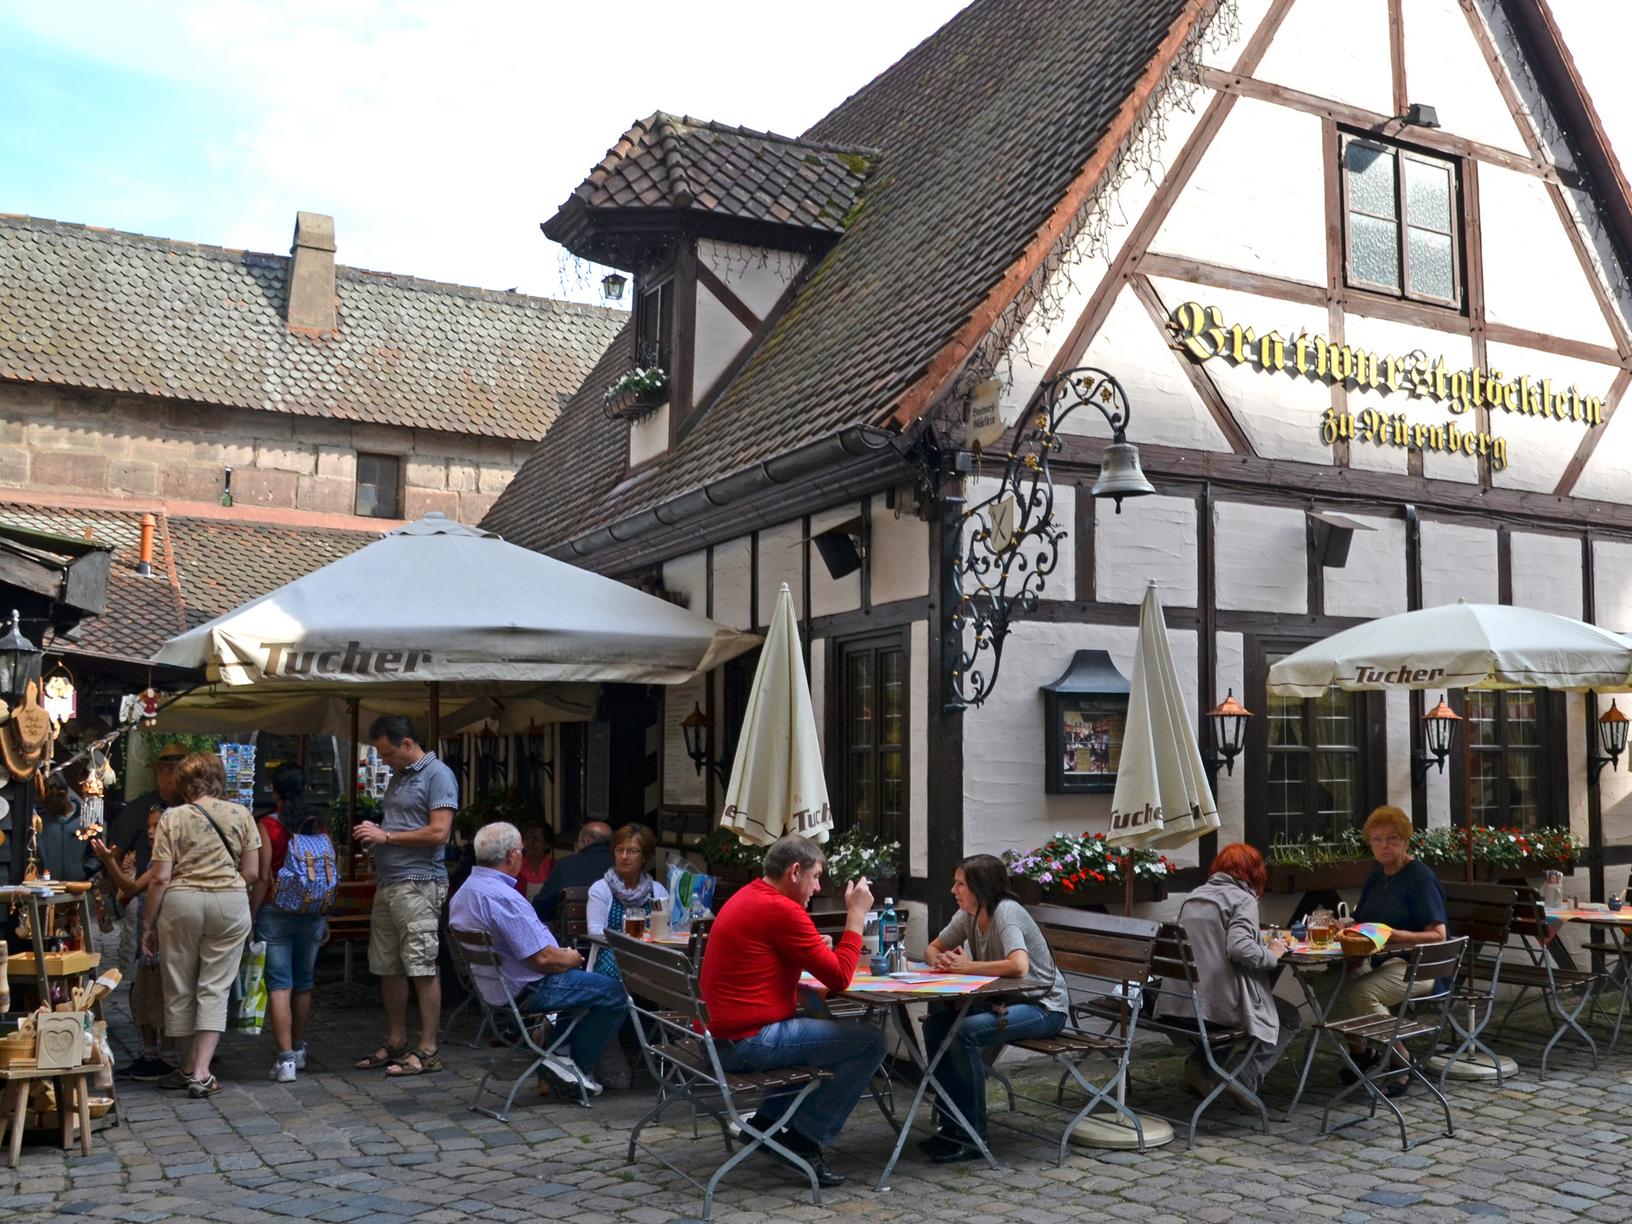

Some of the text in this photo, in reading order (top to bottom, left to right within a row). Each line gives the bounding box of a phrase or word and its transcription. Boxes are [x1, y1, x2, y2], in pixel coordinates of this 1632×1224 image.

[1361, 407, 1508, 471] Nürnberg
[259, 640, 433, 677] Tucher
[1355, 665, 1445, 684] Tucher
